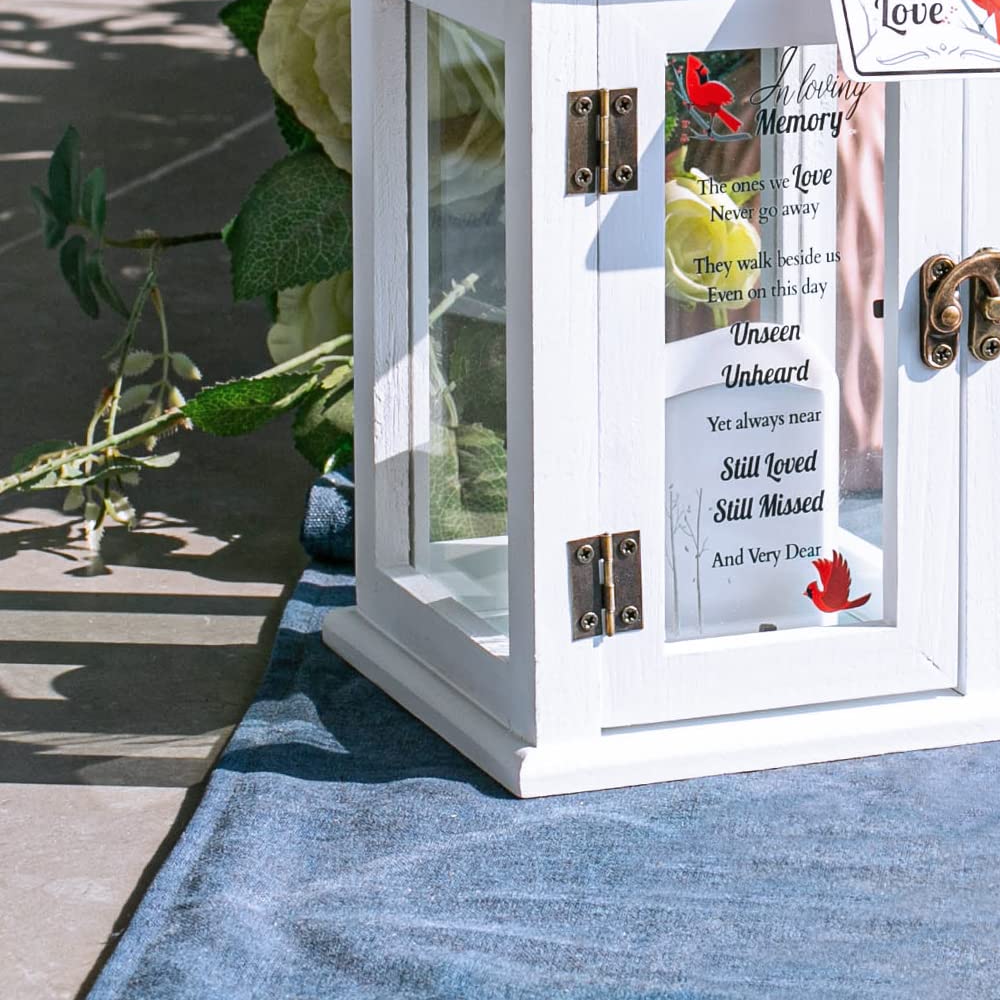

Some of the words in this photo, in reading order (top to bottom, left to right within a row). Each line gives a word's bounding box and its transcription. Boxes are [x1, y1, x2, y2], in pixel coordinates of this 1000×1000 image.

[750, 46, 797, 106] In
[797, 63, 871, 120] loving
[756, 109, 843, 138] Memory
[698, 179, 727, 195] The
[732, 177, 765, 193] ones
[770, 177, 790, 189] we
[792, 164, 832, 193] Love
[711, 205, 755, 222] Never
[759, 206, 778, 224] go
[782, 202, 820, 218] away
[693, 257, 732, 277] They
[738, 252, 772, 270] walk
[778, 247, 821, 267] beside
[826, 250, 841, 263] us
[708, 287, 743, 303] Even
[748, 288, 767, 299] on
[772, 281, 797, 297] this
[802, 277, 828, 296] day
[730, 322, 800, 346] Unseen
[721, 359, 810, 388] Unheard
[708, 415, 731, 432] Yet
[736, 412, 784, 433] always
[789, 410, 822, 424] near
[720, 455, 760, 481] Still
[765, 450, 818, 482] Loved
[713, 497, 753, 523] Still
[758, 490, 825, 519] Missed
[712, 550, 744, 568] And
[749, 547, 781, 567] Very
[785, 543, 822, 560] Dear
